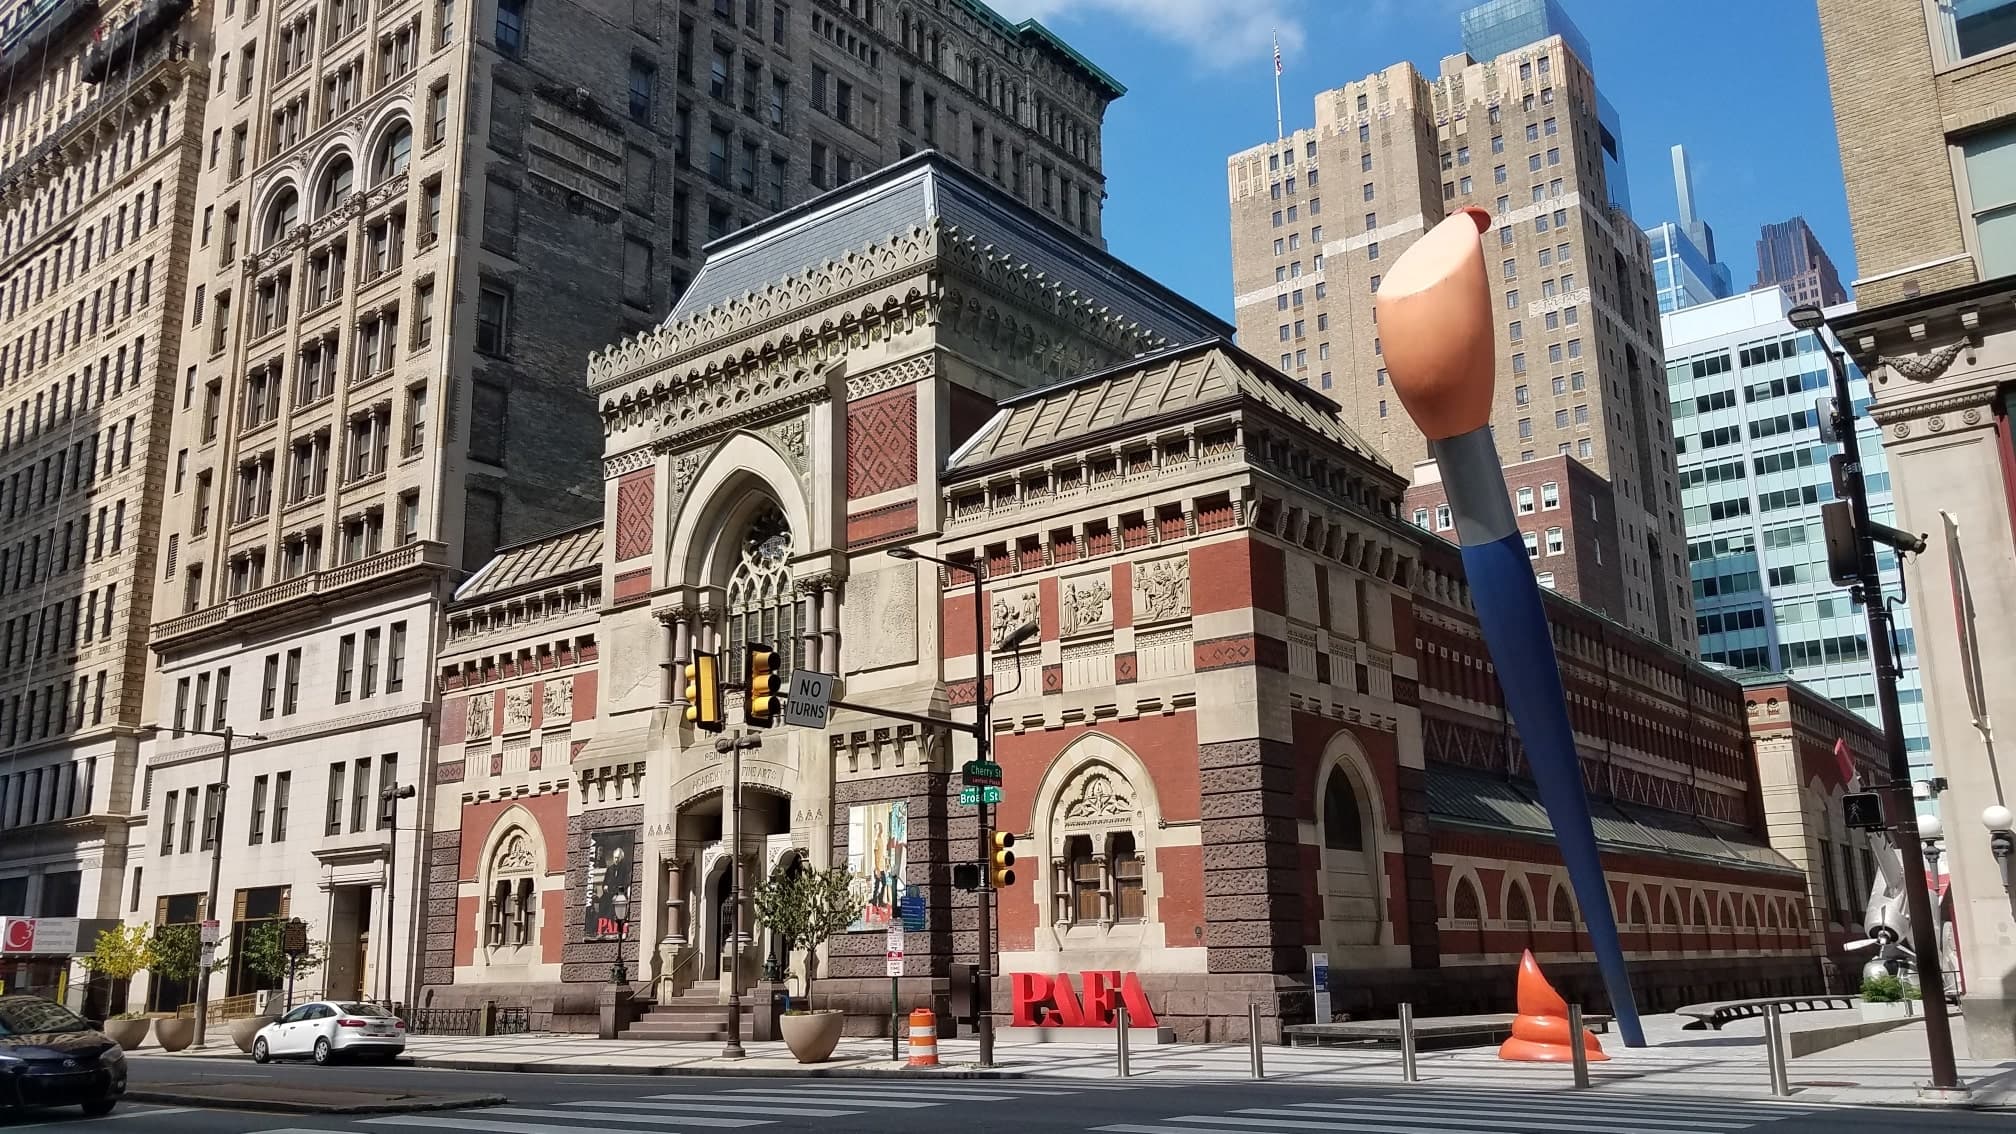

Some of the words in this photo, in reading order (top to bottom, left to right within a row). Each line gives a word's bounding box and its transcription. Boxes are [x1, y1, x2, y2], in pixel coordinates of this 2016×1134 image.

[800, 679, 821, 697] NO
[790, 700, 824, 718] TURNS
[971, 764, 993, 779] Cherry
[989, 791, 999, 802] St
[586, 861, 595, 907] MUSEUM
[1009, 970, 1159, 1028] PAFA
